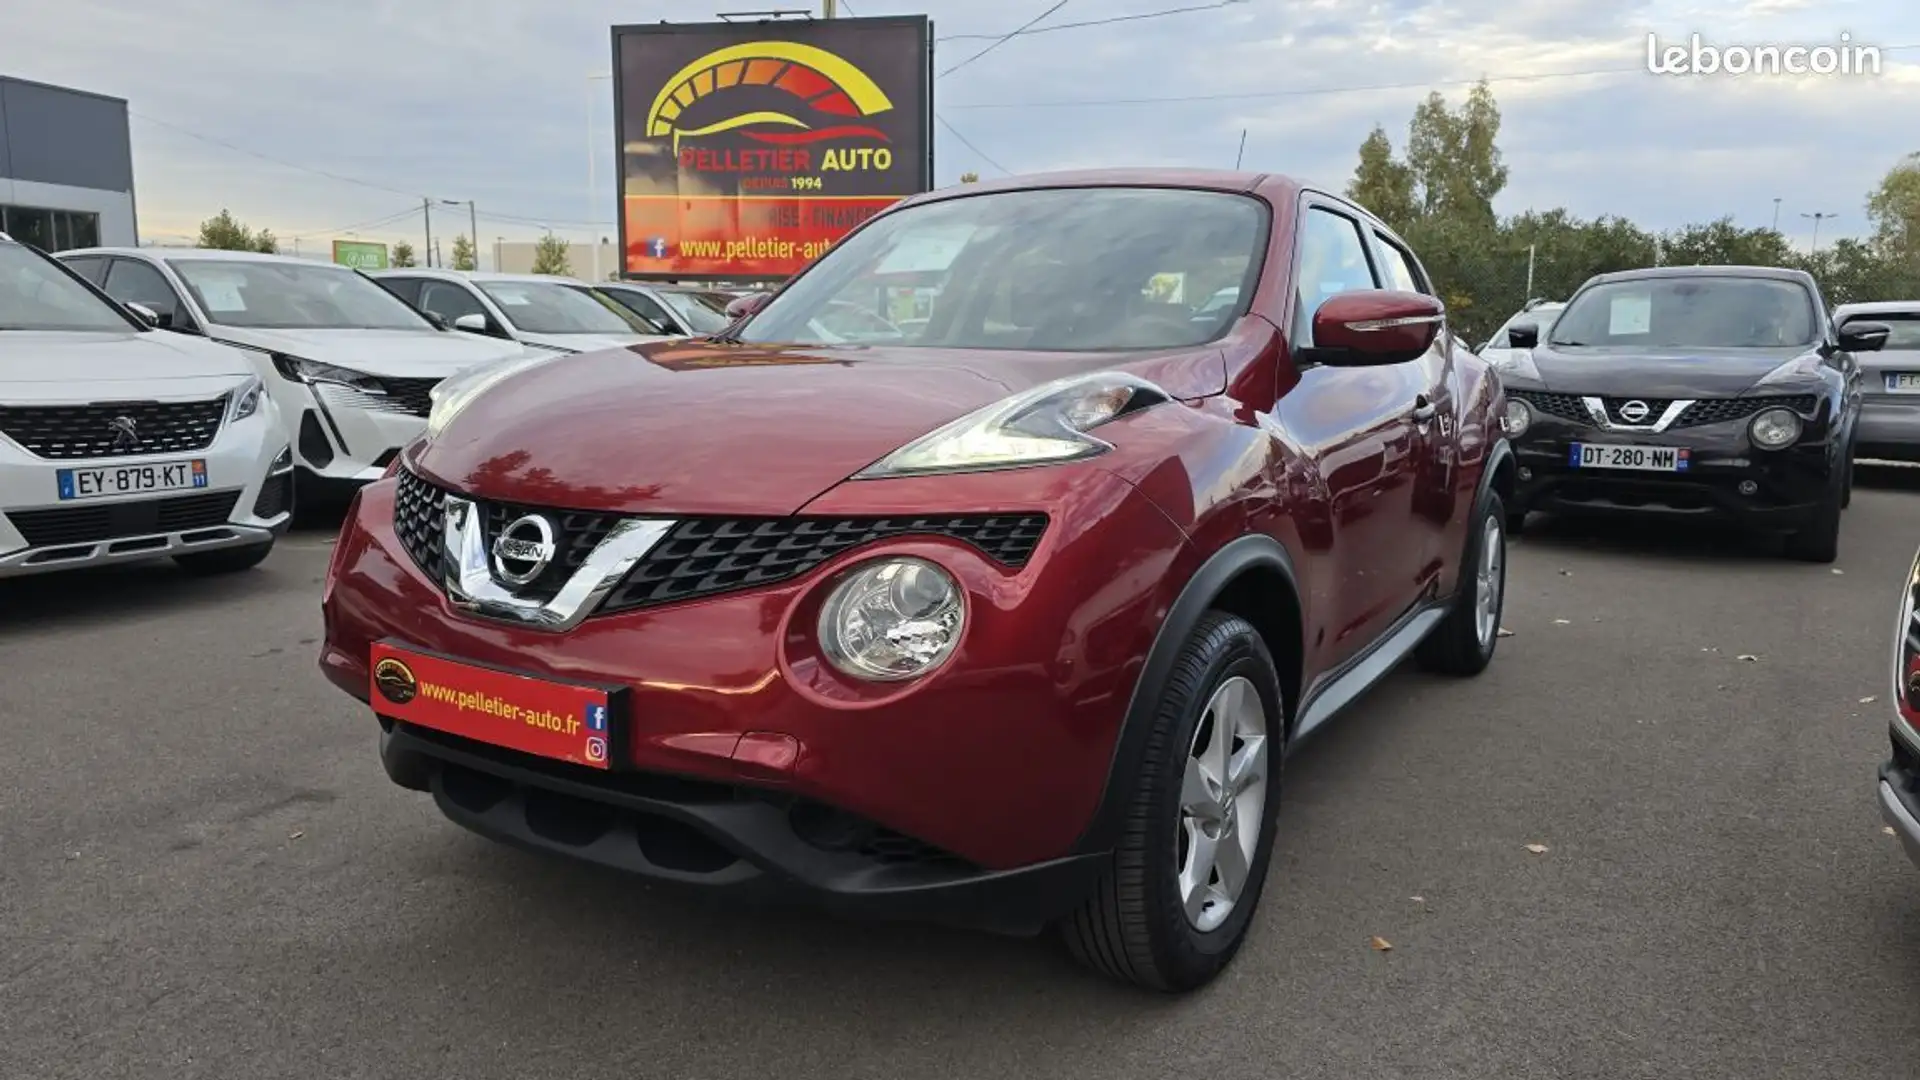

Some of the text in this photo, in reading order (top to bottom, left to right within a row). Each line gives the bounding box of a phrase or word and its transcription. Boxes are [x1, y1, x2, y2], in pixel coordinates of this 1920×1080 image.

[680, 149, 891, 171] PELLETIER AUTO
[790, 176, 822, 189] 1994
[680, 237, 833, 263] www.pelletier-aut
[1583, 446, 1674, 468] DT-280-NM
[78, 465, 187, 494] EY-879-KT
[195, 475, 205, 486] 11
[420, 680, 580, 736] www.pelletier-auto.fr
